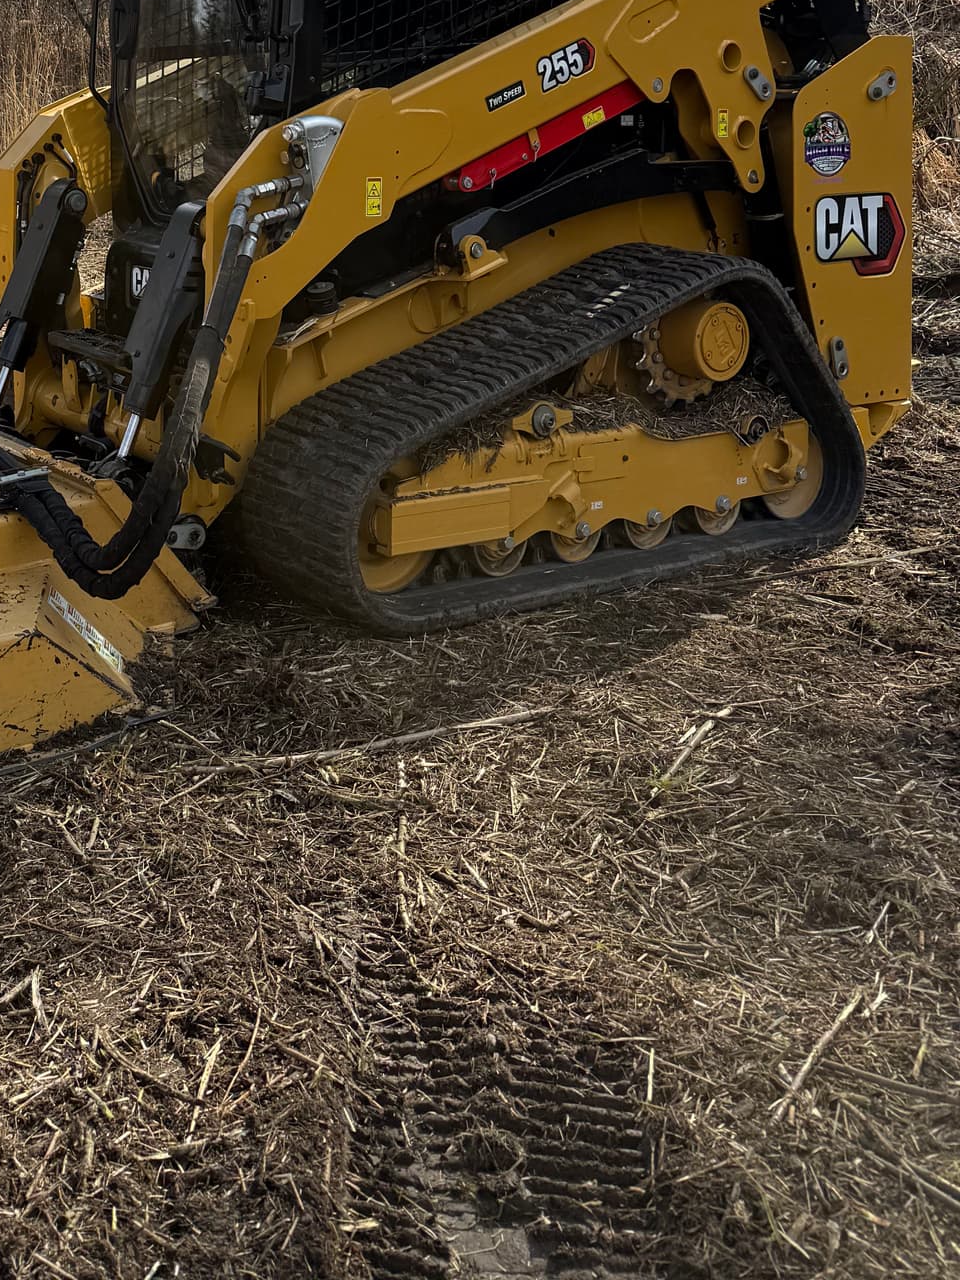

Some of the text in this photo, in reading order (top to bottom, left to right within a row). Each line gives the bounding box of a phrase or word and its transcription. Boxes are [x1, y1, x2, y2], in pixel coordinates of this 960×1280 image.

[537, 42, 584, 91] 255
[816, 195, 883, 260] CAT
[132, 267, 150, 297] CA
